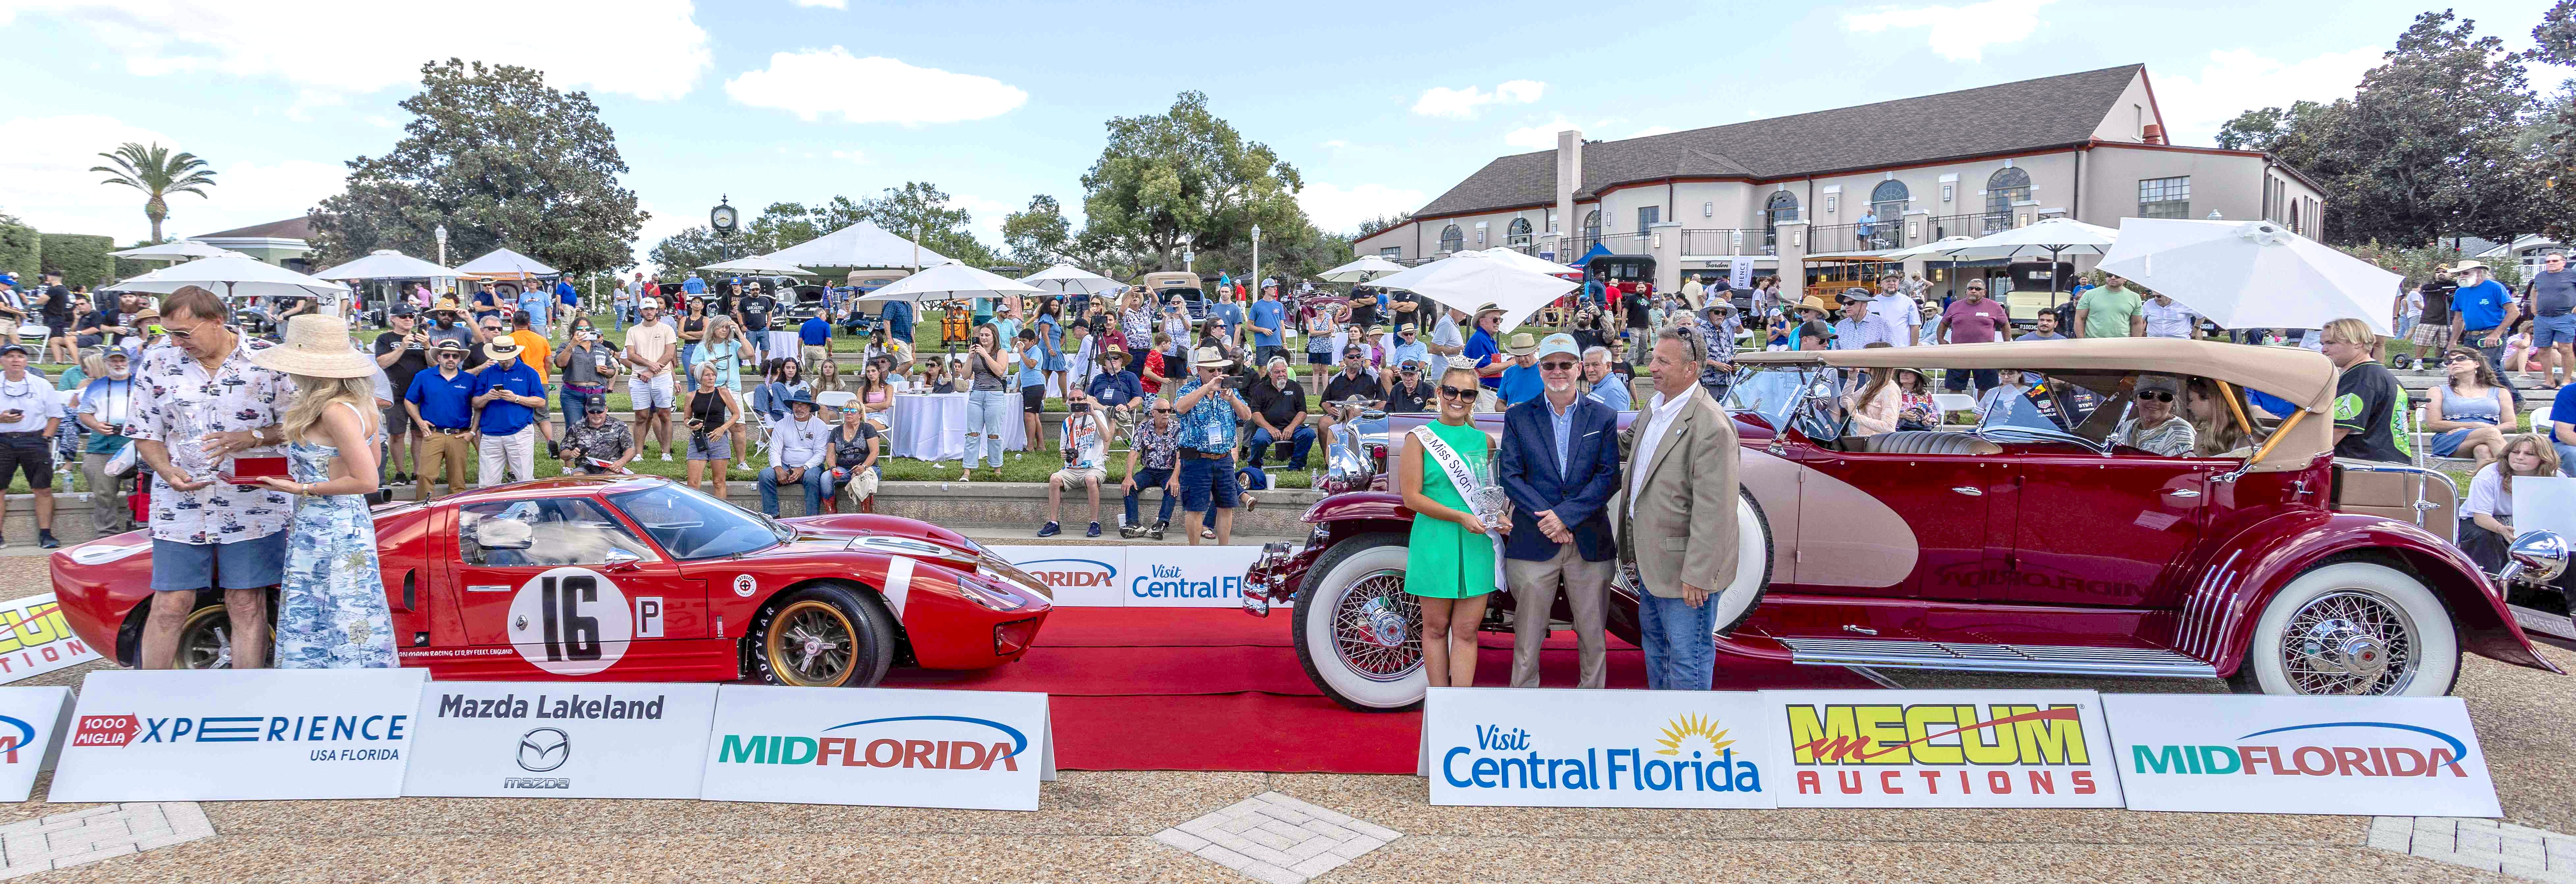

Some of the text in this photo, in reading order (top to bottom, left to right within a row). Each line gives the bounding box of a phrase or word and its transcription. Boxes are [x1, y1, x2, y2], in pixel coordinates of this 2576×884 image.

[1429, 439, 1472, 493] Miss Swan
[1152, 564, 1183, 579] Visit
[1132, 576, 1219, 599] Central
[541, 575, 602, 663] 16
[641, 601, 659, 634] P
[438, 694, 665, 720] Mazda Lakeland
[85, 718, 127, 729] 1000
[141, 715, 406, 743] XPERIENCE
[1785, 703, 2091, 766] MECUM
[76, 732, 125, 744] MIGLIA
[1475, 724, 1531, 751] Visit
[310, 749, 399, 761] USA FLORIDA
[718, 734, 1019, 772] MIDFLORIDA
[2131, 745, 2469, 778] MIDFLORIDA
[1443, 746, 1762, 793] Central Florida
[1797, 770, 2097, 794] AUCTIONS
